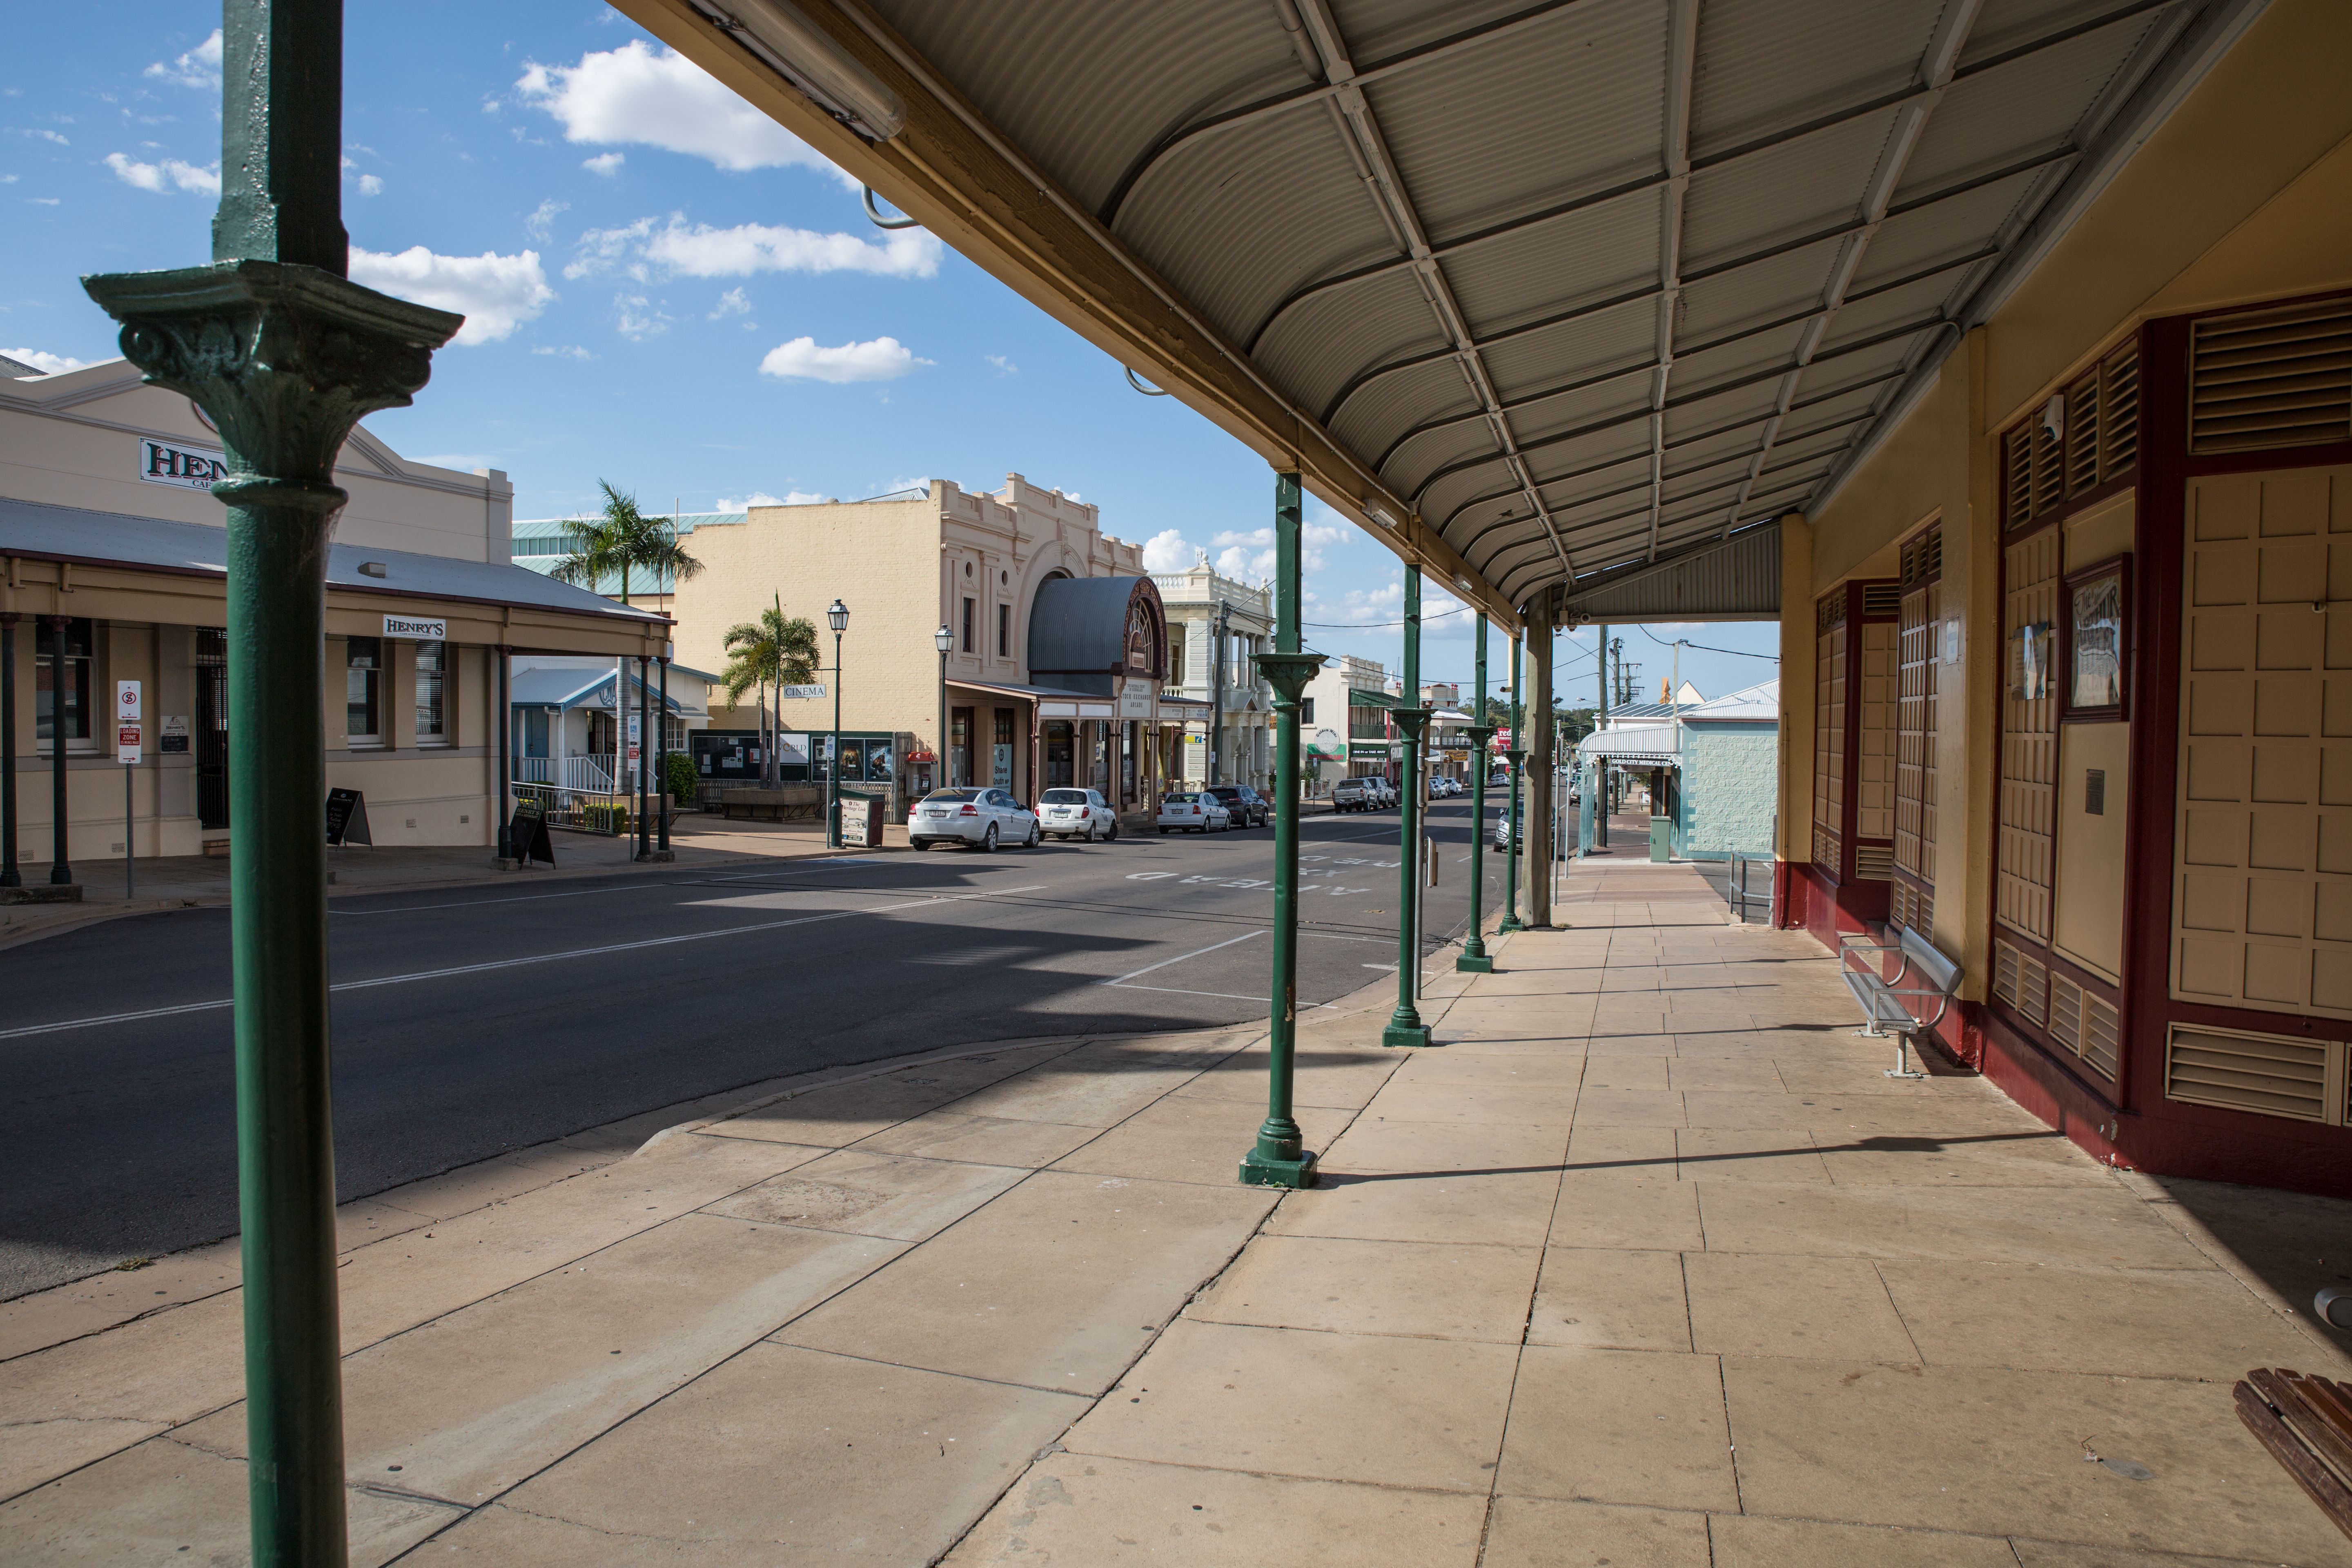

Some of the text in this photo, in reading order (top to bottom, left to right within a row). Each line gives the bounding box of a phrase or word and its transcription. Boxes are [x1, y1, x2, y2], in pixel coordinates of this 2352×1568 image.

[192, 480, 212, 488] CAF
[387, 619, 443, 636] HENRY'S
[785, 687, 824, 696] CINEMA
[1391, 747, 1403, 759] GOLDE
[995, 766, 1007, 774] Shane
